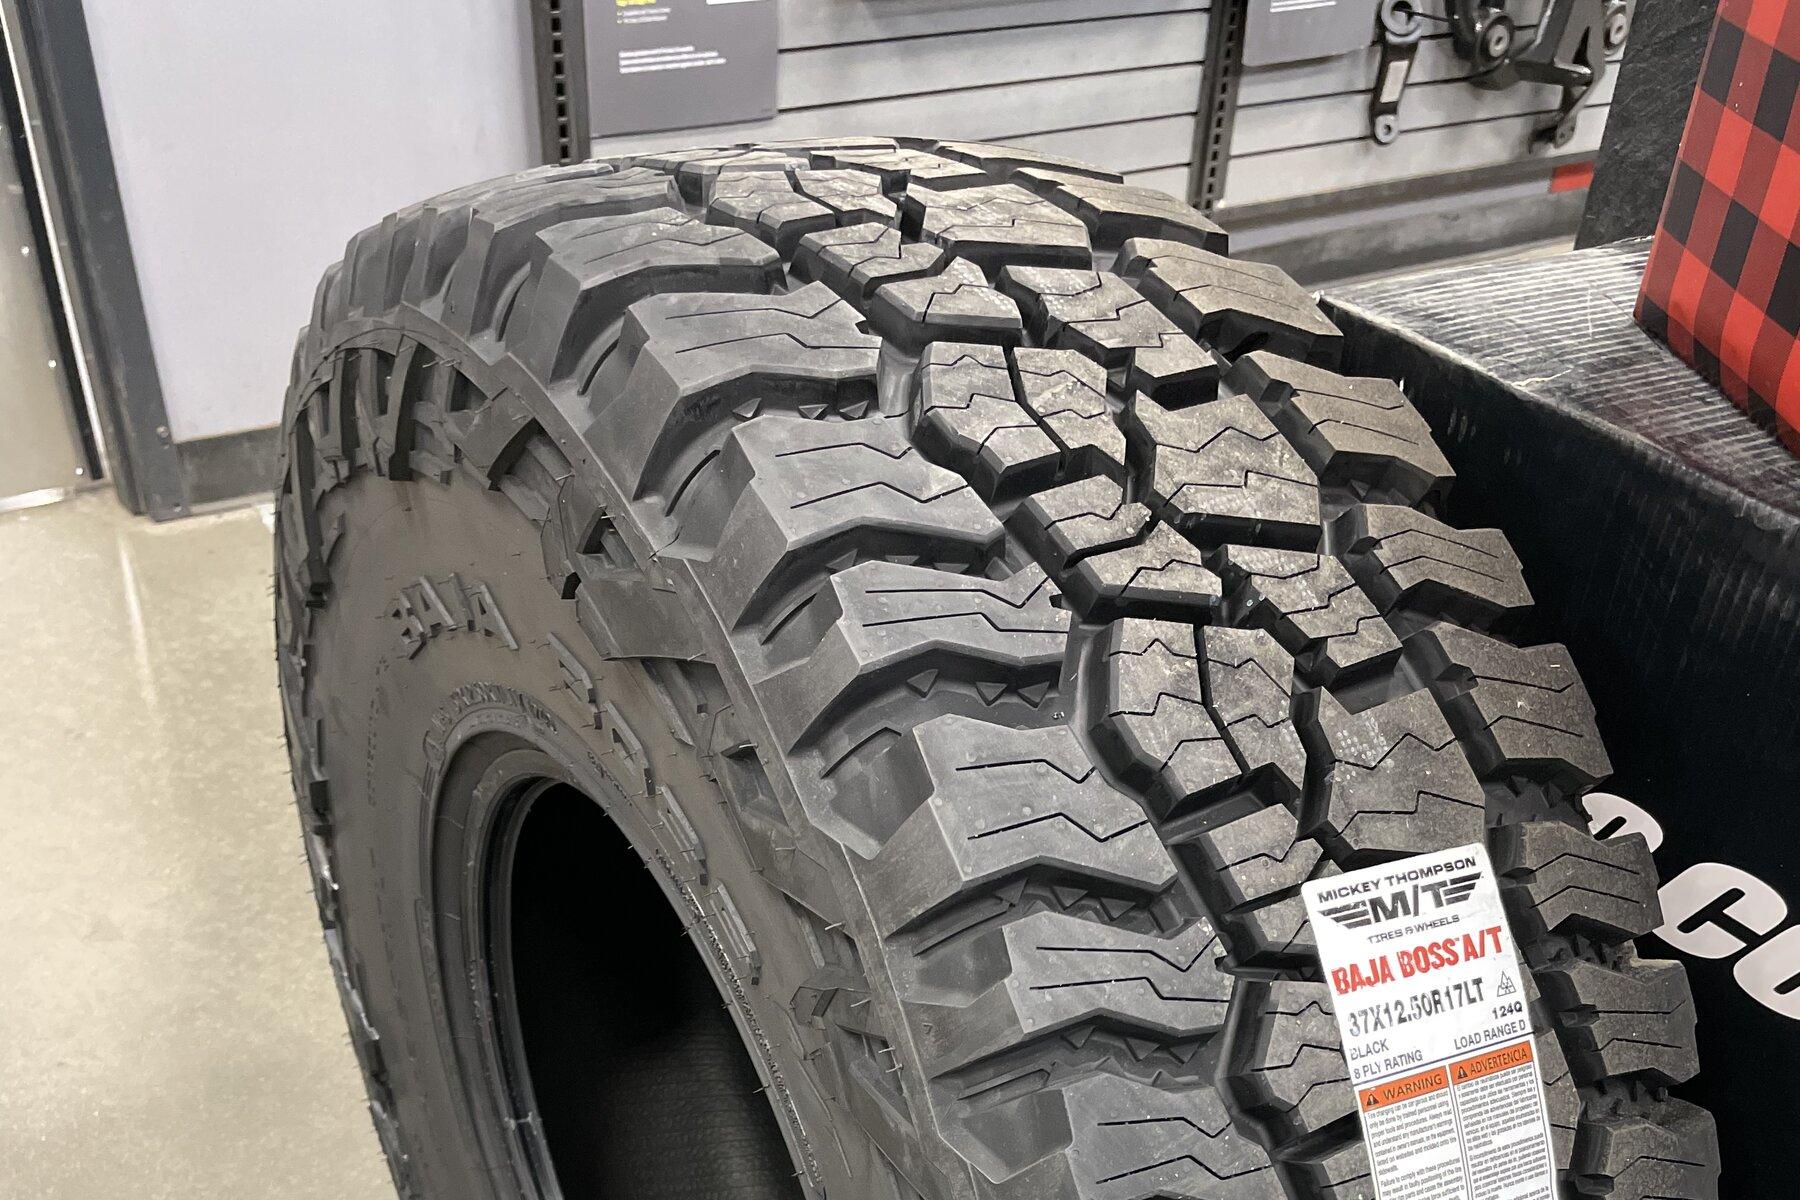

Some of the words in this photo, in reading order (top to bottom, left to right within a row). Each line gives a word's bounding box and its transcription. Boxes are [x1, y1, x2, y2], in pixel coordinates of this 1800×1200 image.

[1317, 879, 1381, 904] MICKEY
[1384, 856, 1477, 887] THOMPSON
[1368, 929, 1403, 945] TIRES
[1415, 914, 1461, 933] WHEELS
[1331, 954, 1396, 996] BAJA
[1397, 937, 1460, 979] BOSS
[1463, 925, 1503, 962] A/T
[1348, 977, 1485, 1038] 37X12.50R17LT
[1491, 1001, 1524, 1020] 124Q
[1350, 1038, 1389, 1062] BLACK
[1453, 1032, 1482, 1051] LOAD
[1483, 1022, 1519, 1043] RANGE
[1518, 1018, 1527, 1031] D
[1353, 1067, 1362, 1080] 8
[1362, 1060, 1382, 1078] PLY
[1384, 1049, 1424, 1072] RATING
[1470, 1047, 1528, 1075] ADVERTENCIA
[1383, 1073, 1443, 1101] WARNING
